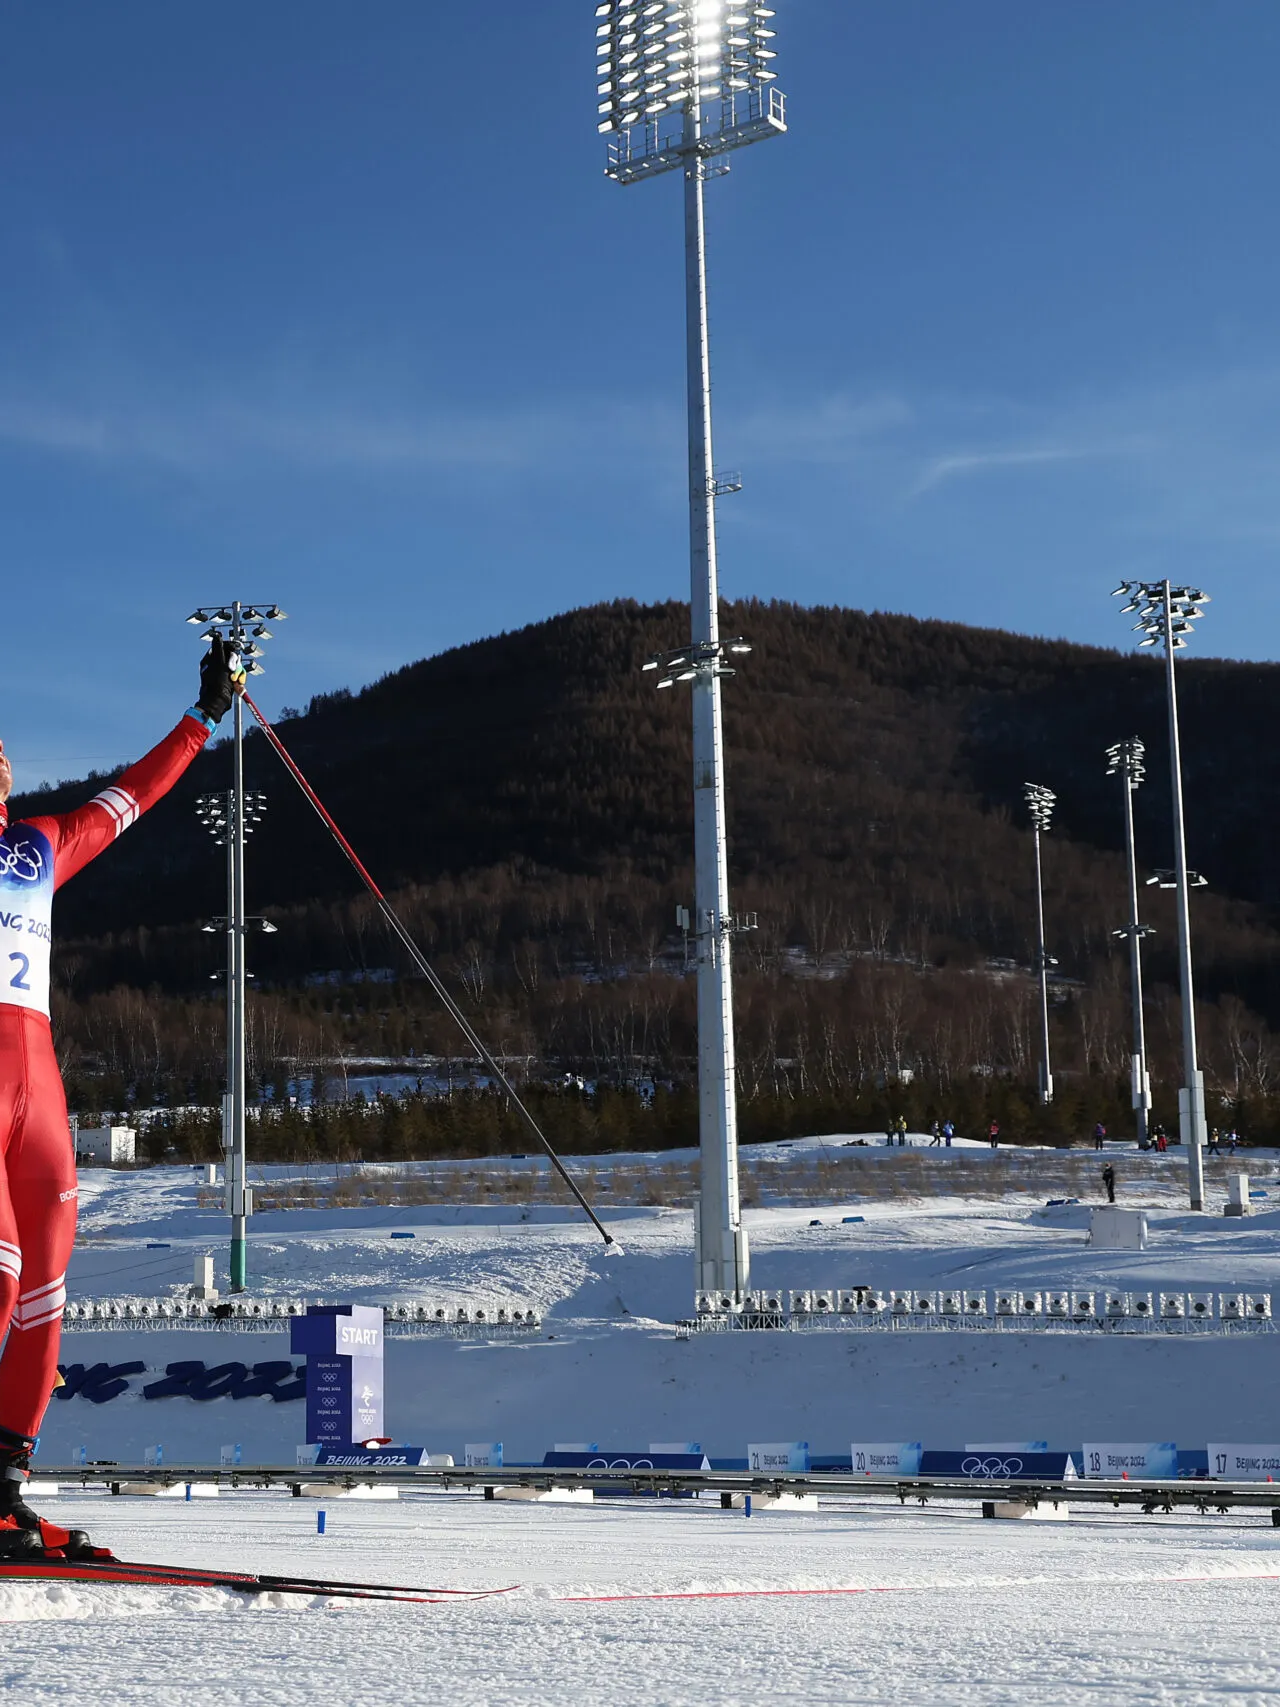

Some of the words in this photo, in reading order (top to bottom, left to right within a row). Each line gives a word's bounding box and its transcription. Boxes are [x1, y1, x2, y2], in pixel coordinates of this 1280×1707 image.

[8, 952, 30, 991] 2
[341, 1326, 378, 1345] START
[372, 1456, 408, 1465] 2022
[856, 1452, 866, 1470] 20
[1089, 1452, 1101, 1472] 18
[1107, 1455, 1129, 1469] BEIJING
[1130, 1456, 1146, 1467] 2022
[1215, 1453, 1227, 1474] 17
[1236, 1457, 1260, 1472] BEIJING
